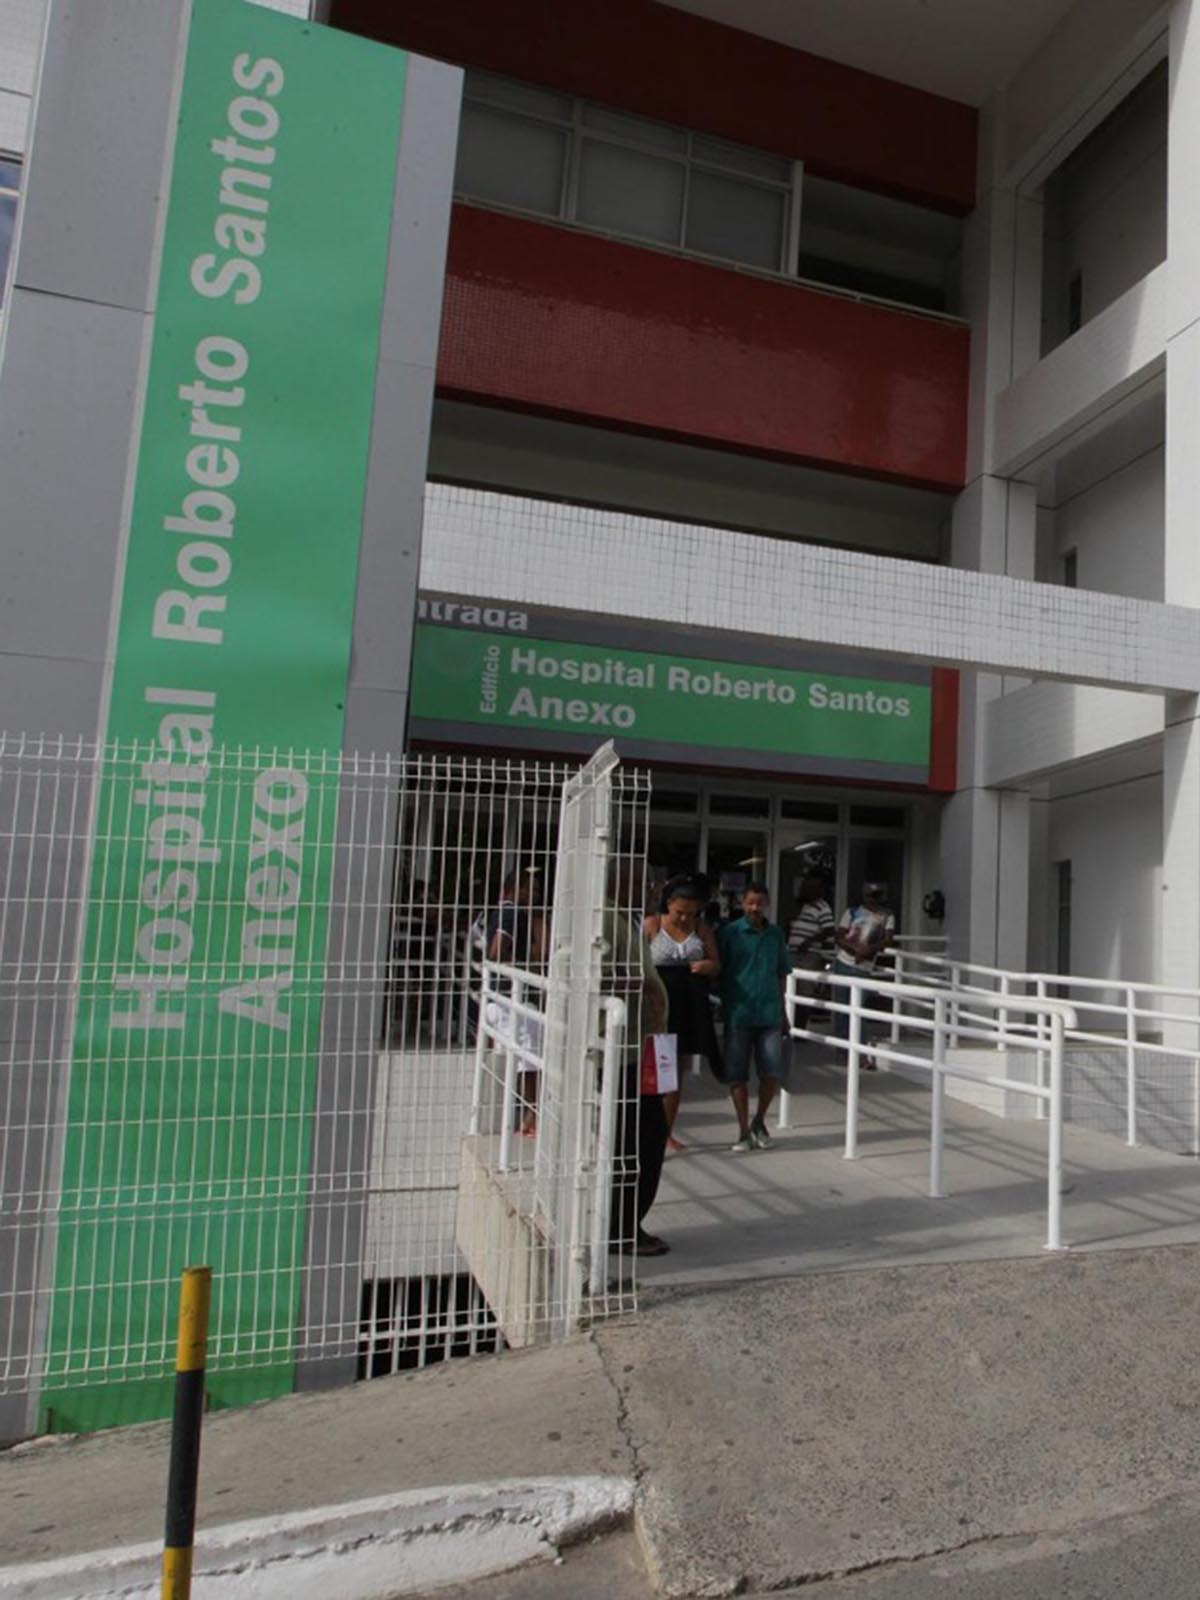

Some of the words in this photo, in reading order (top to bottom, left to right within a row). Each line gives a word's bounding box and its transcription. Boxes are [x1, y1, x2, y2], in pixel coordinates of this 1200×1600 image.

[190, 53, 285, 305] Santos
[152, 336, 249, 645] Roberto
[508, 687, 637, 728] Anexo
[510, 647, 655, 688] Hospital
[668, 666, 796, 704] Roberto
[808, 683, 911, 717] Santos
[109, 687, 221, 1030] Hospital
[219, 767, 309, 1032] Anexo
